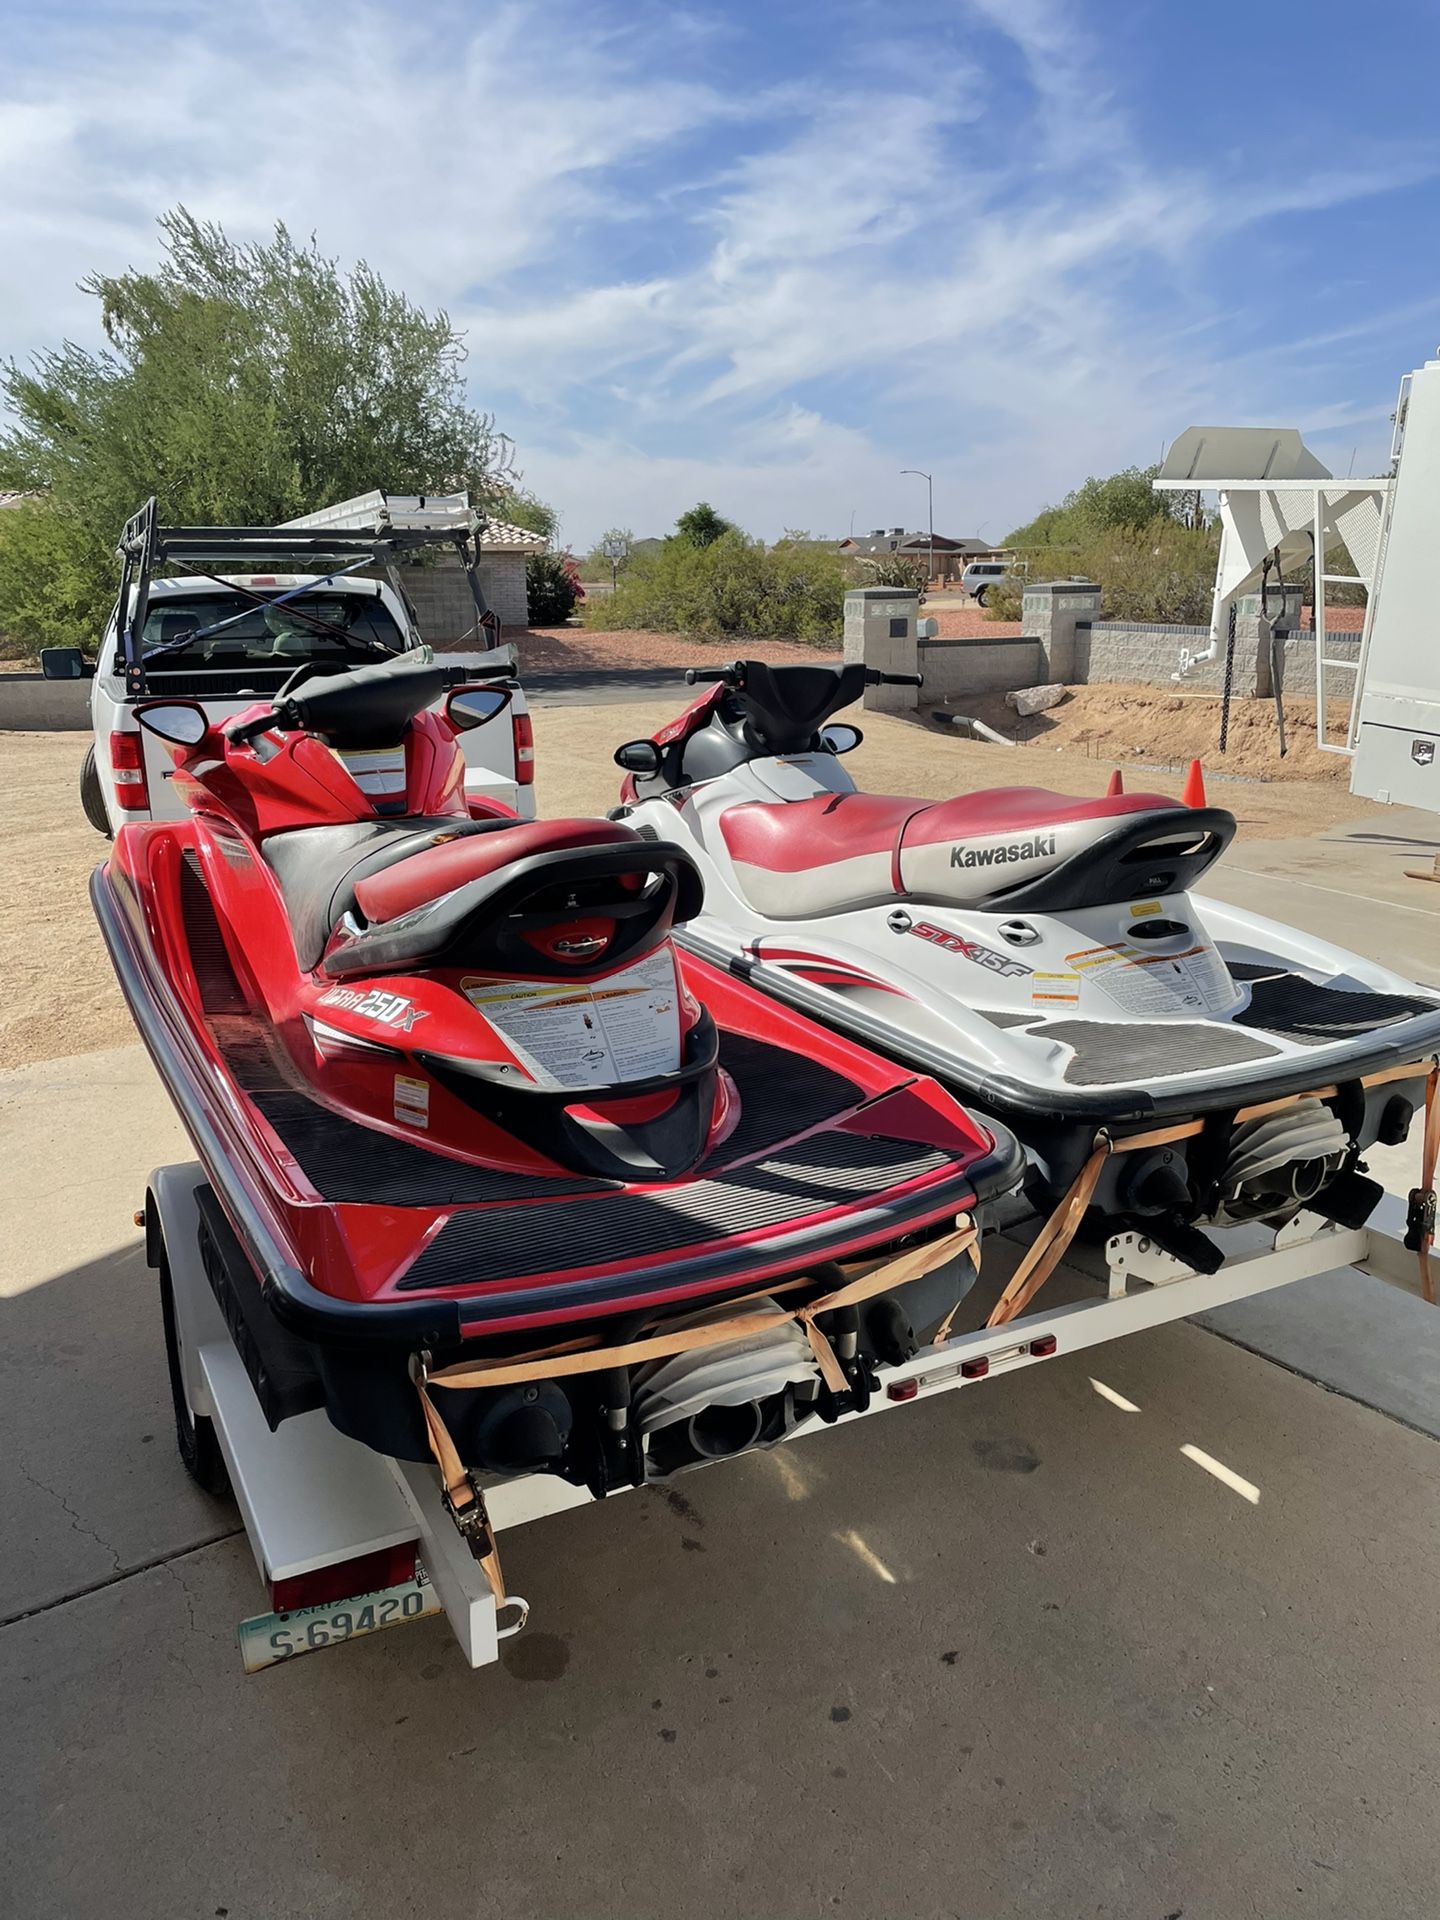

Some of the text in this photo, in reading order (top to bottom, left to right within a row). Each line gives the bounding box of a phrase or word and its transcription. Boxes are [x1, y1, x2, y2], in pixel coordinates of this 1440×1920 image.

[950, 833, 1056, 868] Kawasaki
[316, 987, 431, 1032] ULTRA 250X
[270, 1591, 423, 1659] S-69420
